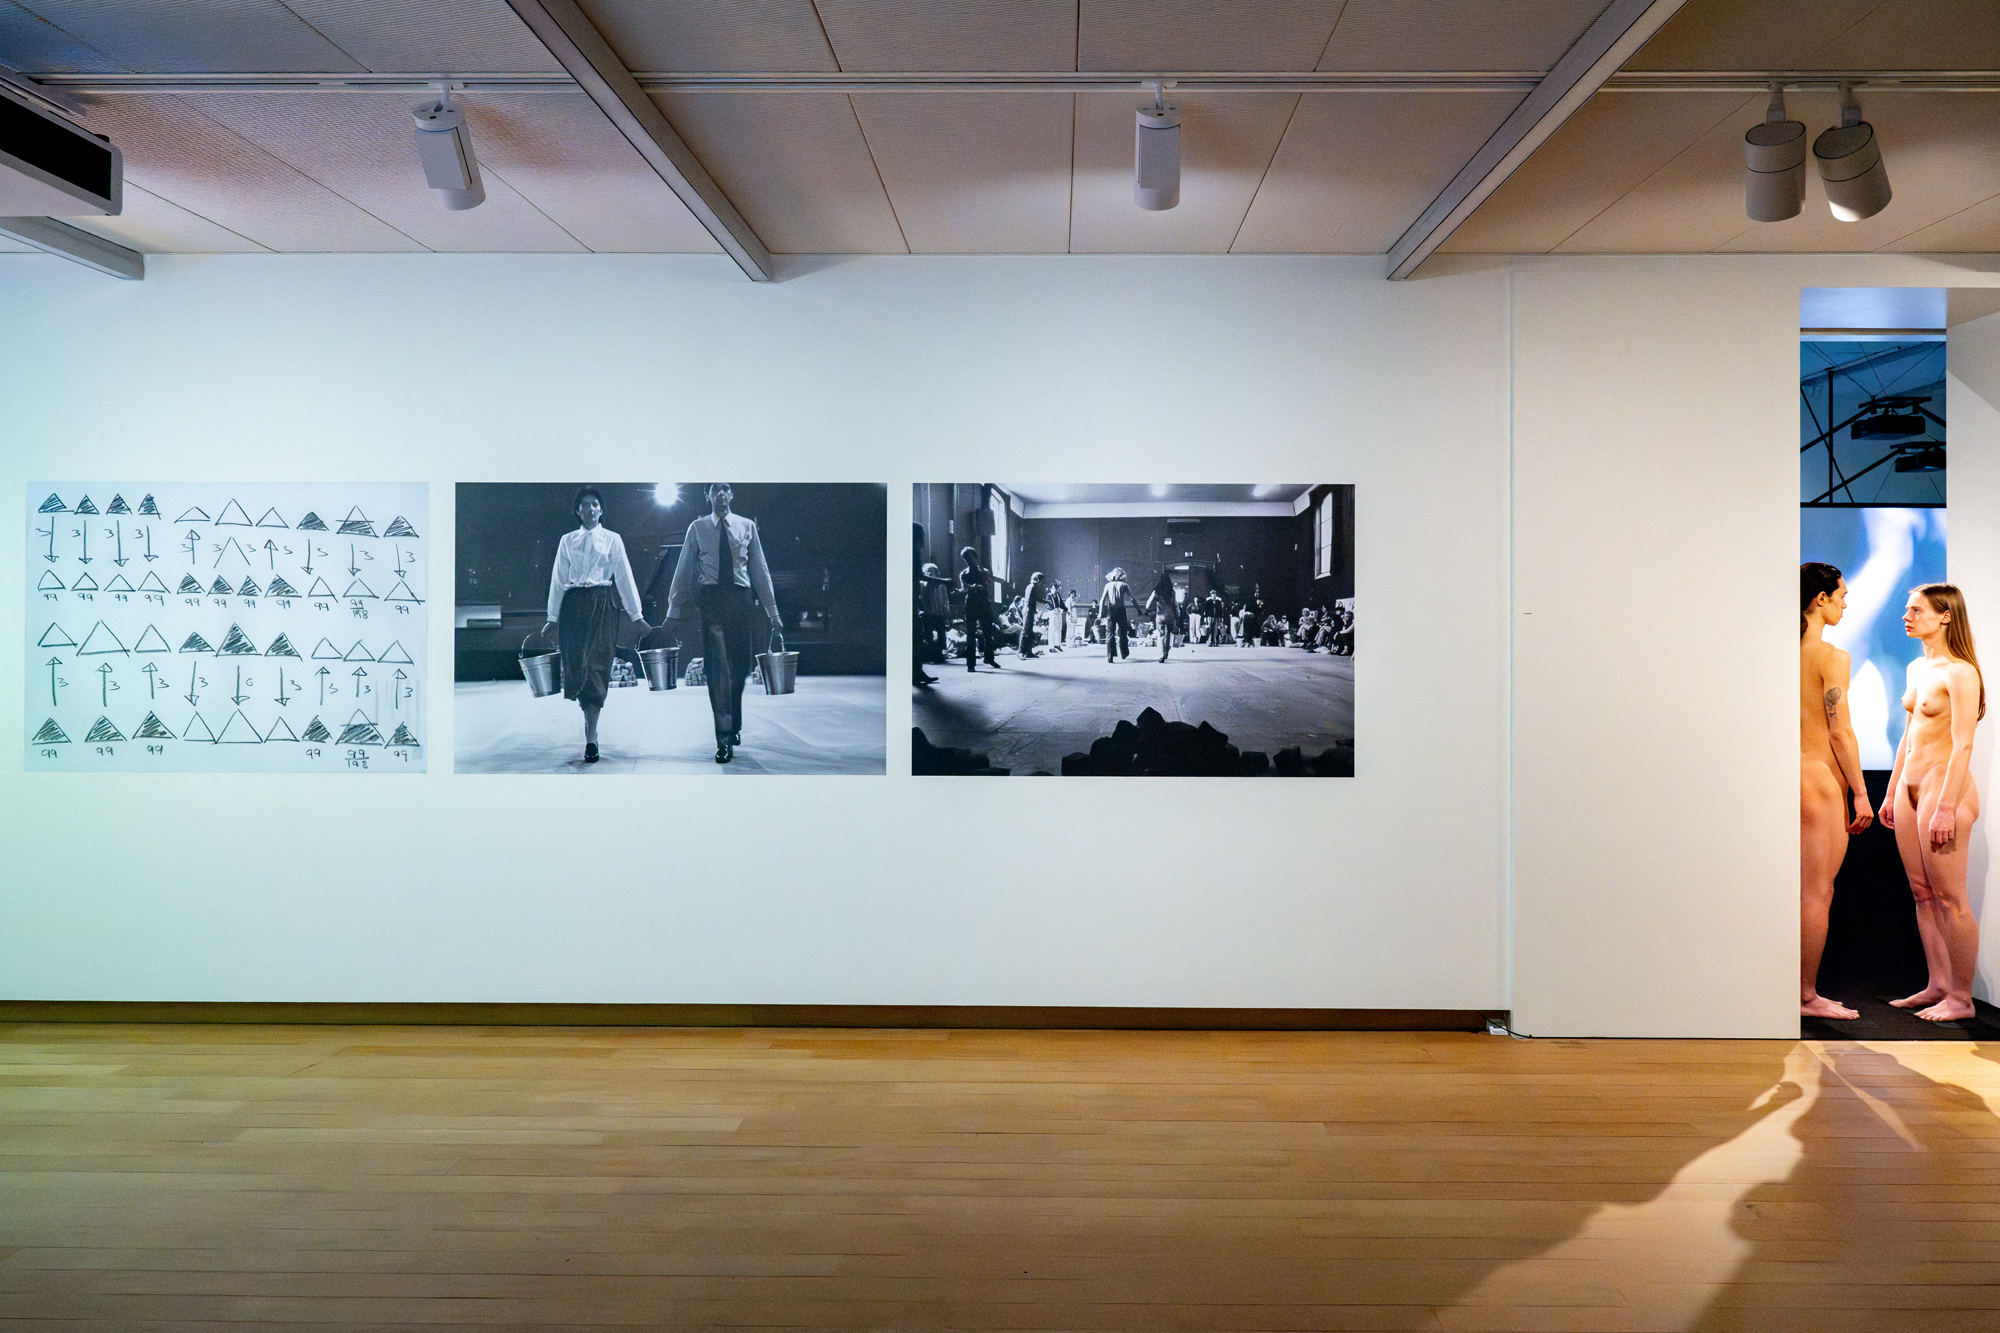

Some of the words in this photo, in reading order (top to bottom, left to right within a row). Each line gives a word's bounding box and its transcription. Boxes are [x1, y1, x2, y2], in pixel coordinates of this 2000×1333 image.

[72, 529, 81, 538] 3
[103, 529, 115, 538] 3
[134, 529, 144, 539] 3
[212, 544, 222, 552] 3
[247, 544, 257, 553] 3
[283, 545, 293, 555] 3
[359, 550, 374, 561] 3
[405, 551, 416, 563] 3
[43, 593, 59, 602] 99
[77, 593, 94, 602] 99
[114, 594, 128, 602] 99
[314, 602, 330, 611] 99
[395, 605, 410, 614] 99
[57, 677, 69, 688] 3
[109, 680, 121, 691] 3
[156, 677, 170, 689] 3
[199, 677, 208, 688] 3
[290, 680, 302, 691] 3
[328, 683, 339, 694] 3
[364, 685, 371, 694] 3
[403, 687, 414, 698] 3
[41, 748, 58, 759] 99
[96, 747, 114, 756] 99
[306, 748, 321, 760] 99
[347, 749, 365, 759] 99
